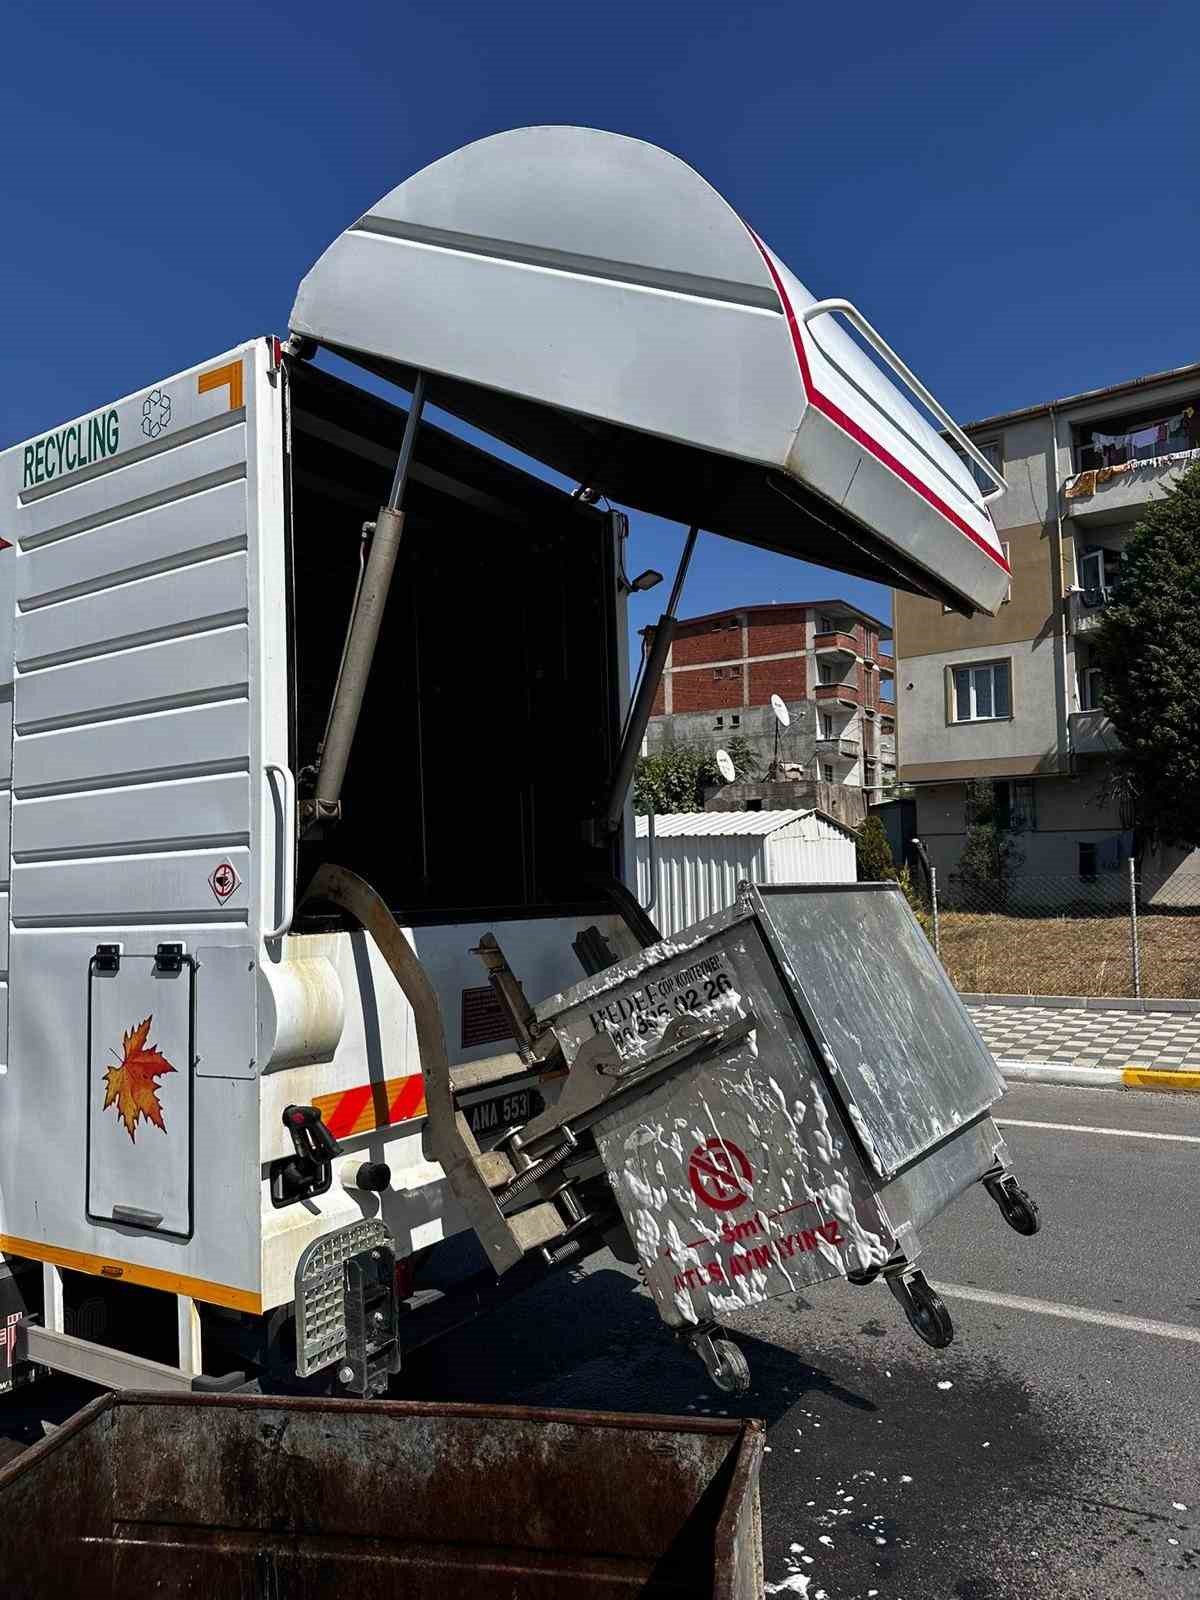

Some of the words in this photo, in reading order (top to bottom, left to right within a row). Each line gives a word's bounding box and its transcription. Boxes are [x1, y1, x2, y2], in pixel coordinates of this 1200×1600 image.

[24, 409, 119, 487] RECYCLING
[703, 973, 733, 1001] 26
[503, 1093, 527, 1121] 553
